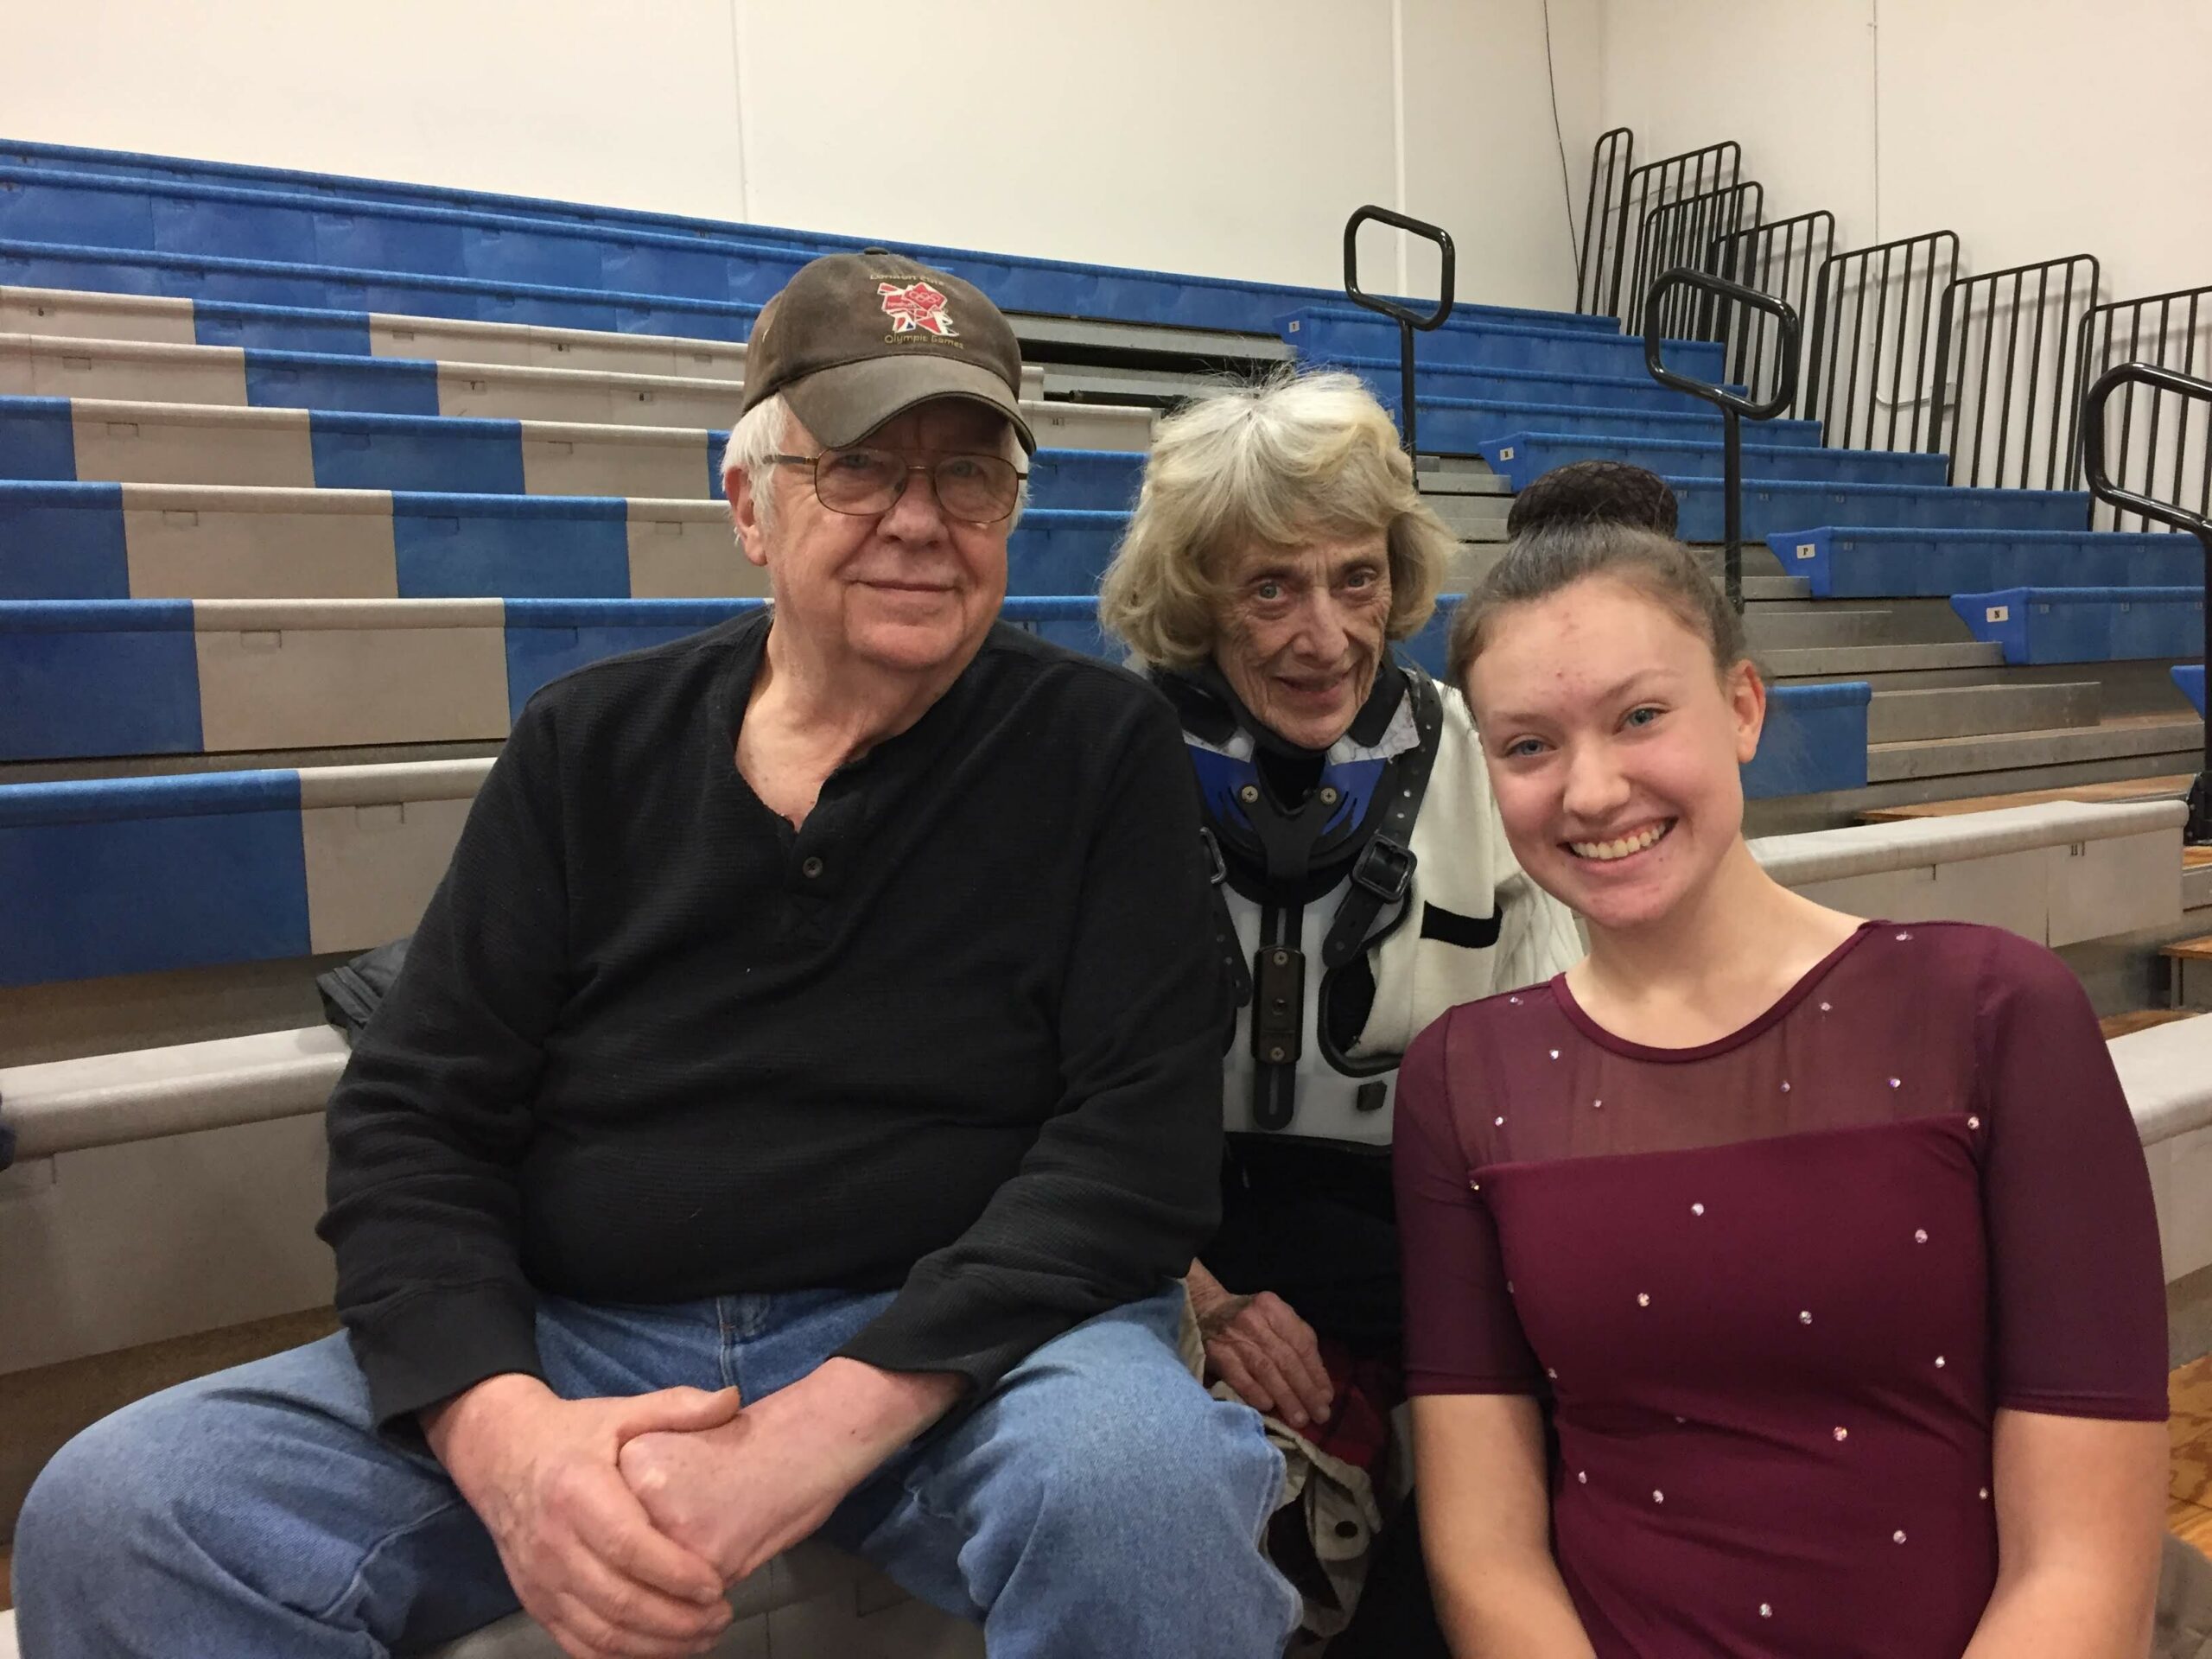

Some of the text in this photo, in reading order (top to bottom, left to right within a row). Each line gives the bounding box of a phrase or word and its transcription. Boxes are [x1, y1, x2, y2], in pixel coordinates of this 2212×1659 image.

[884, 333, 964, 349] Olympic Games
[1802, 547, 1808, 556] P
[1993, 610, 2000, 619] N
